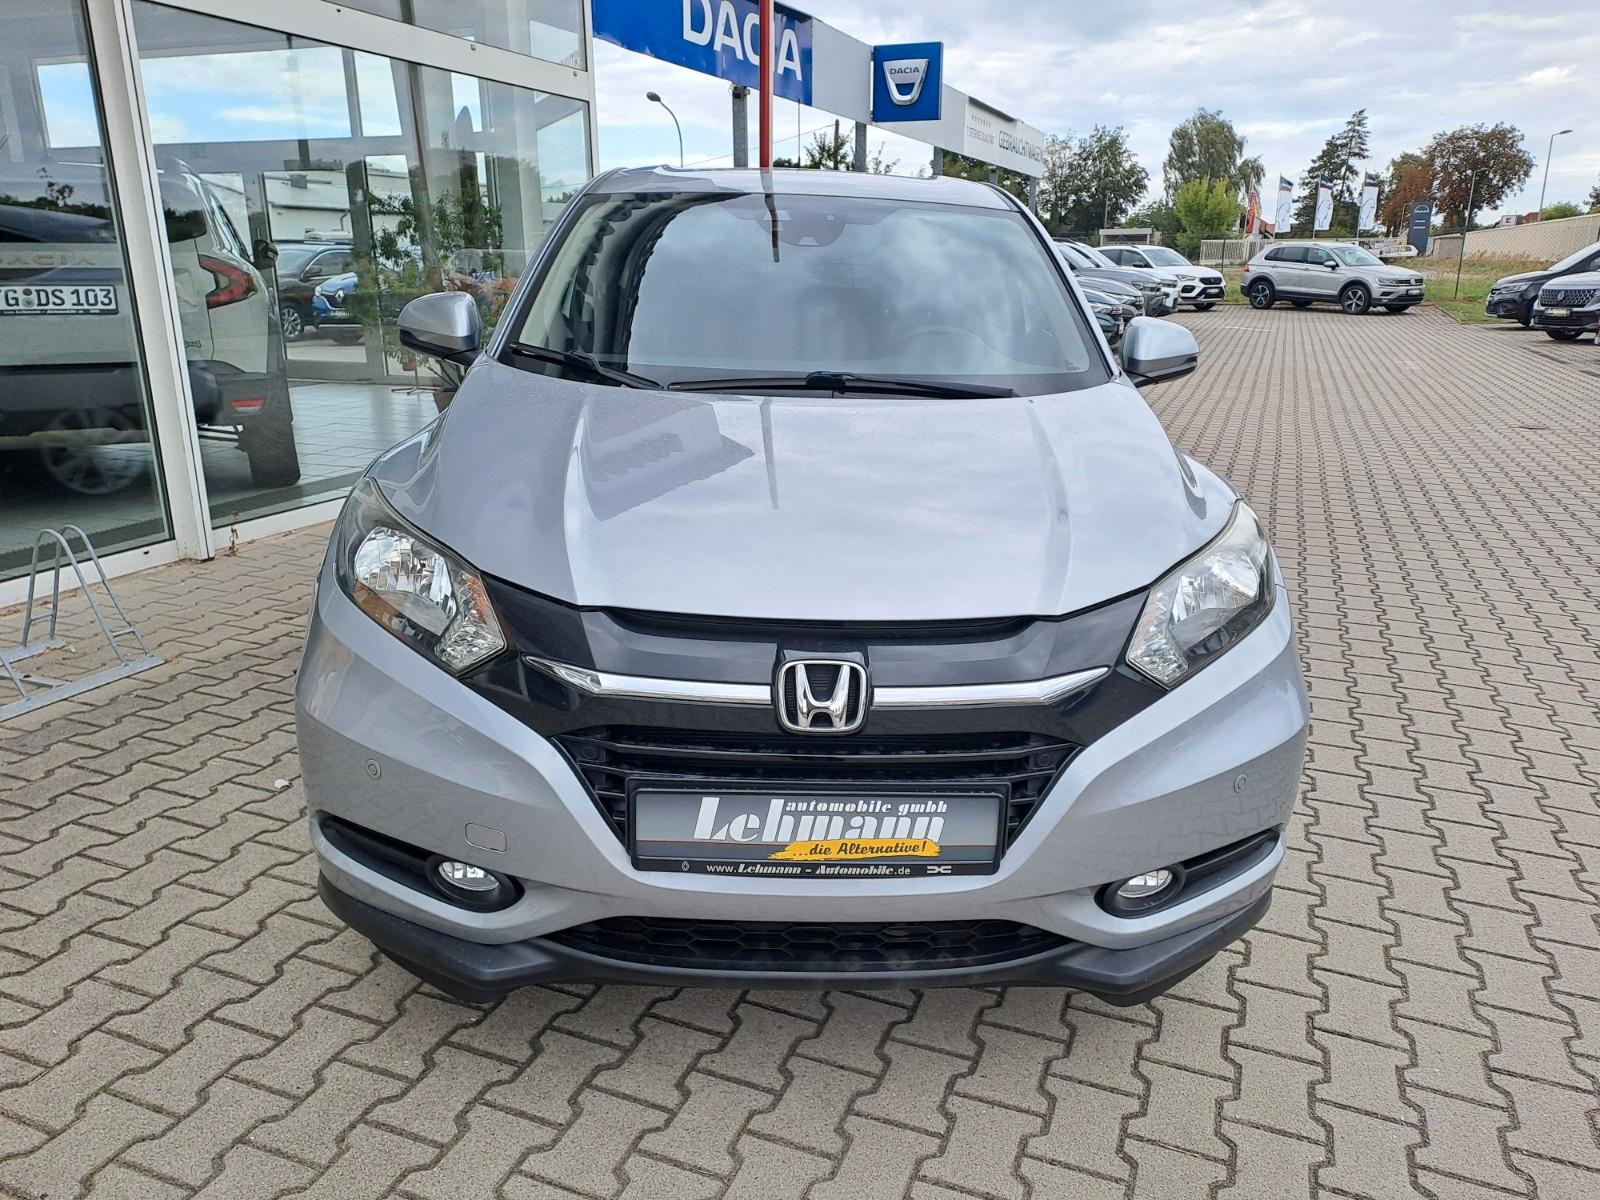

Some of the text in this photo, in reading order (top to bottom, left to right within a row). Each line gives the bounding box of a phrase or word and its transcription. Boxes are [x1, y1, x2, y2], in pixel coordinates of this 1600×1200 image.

[683, 0, 803, 81] DACA
[889, 66, 920, 75] DACIA
[0, 254, 96, 266] ACIA
[35, 288, 66, 307] DS
[71, 288, 113, 307] 103
[785, 800, 948, 816] automobile gmbh
[693, 796, 945, 843] Lehmann
[836, 840, 927, 855] Alternative!
[815, 865, 911, 876] Automobile.de
